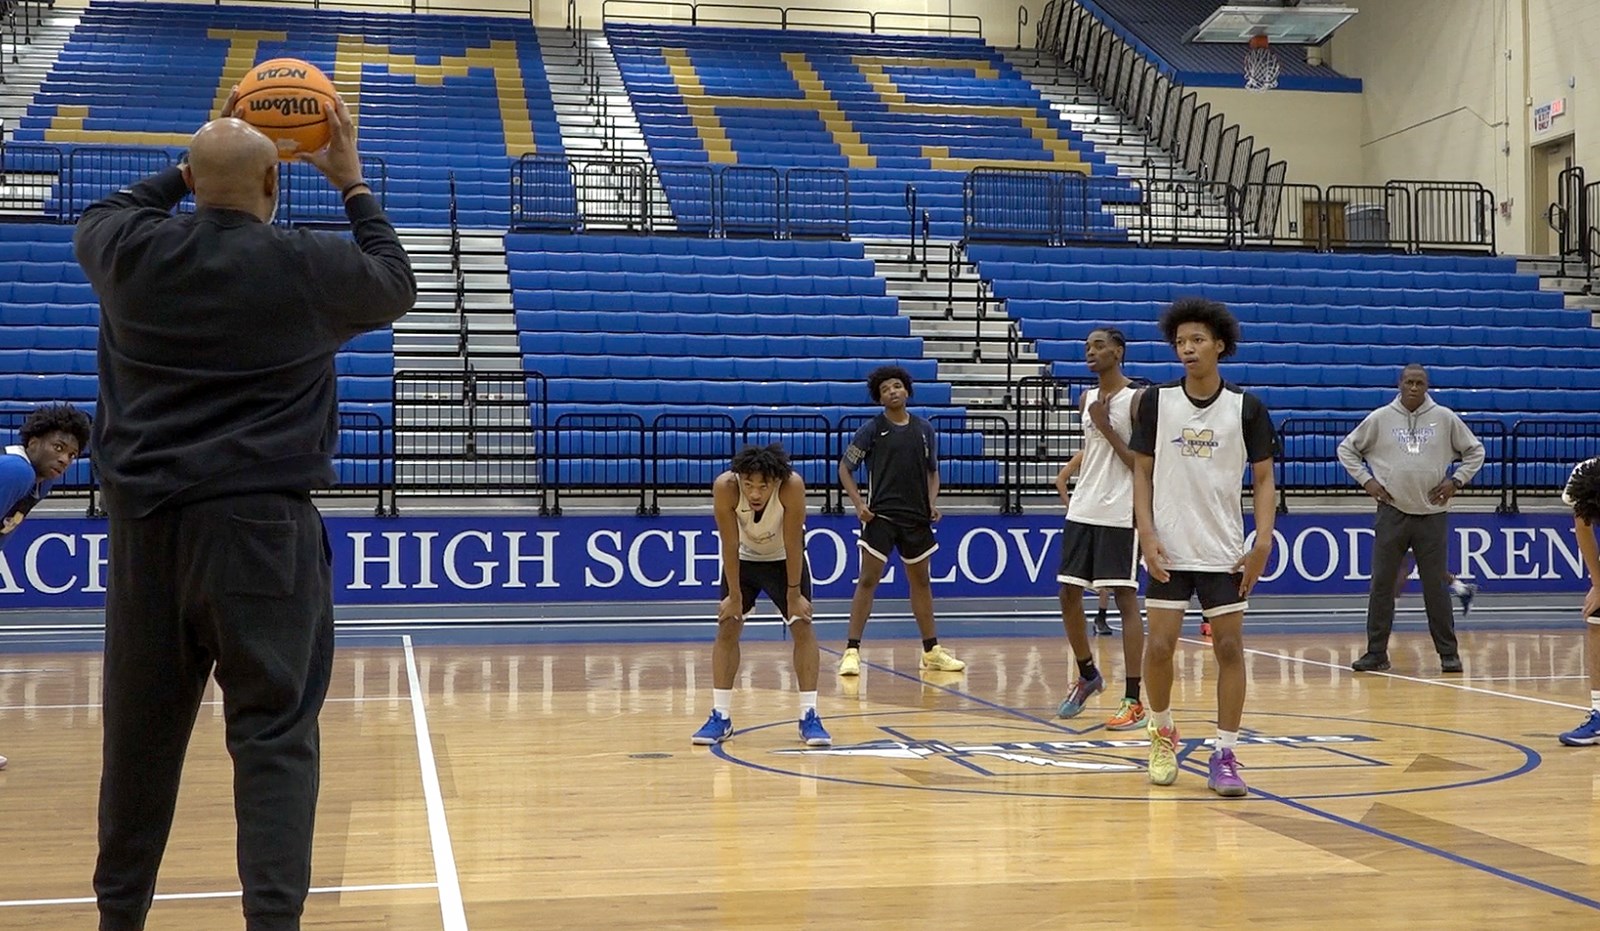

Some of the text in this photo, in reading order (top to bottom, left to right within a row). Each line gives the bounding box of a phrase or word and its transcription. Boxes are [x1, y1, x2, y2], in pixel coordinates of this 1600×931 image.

[249, 97, 321, 116] Wilson
[1181, 428, 1214, 459] M
[347, 527, 1591, 589] HIGH SCHO OVOOD REN
